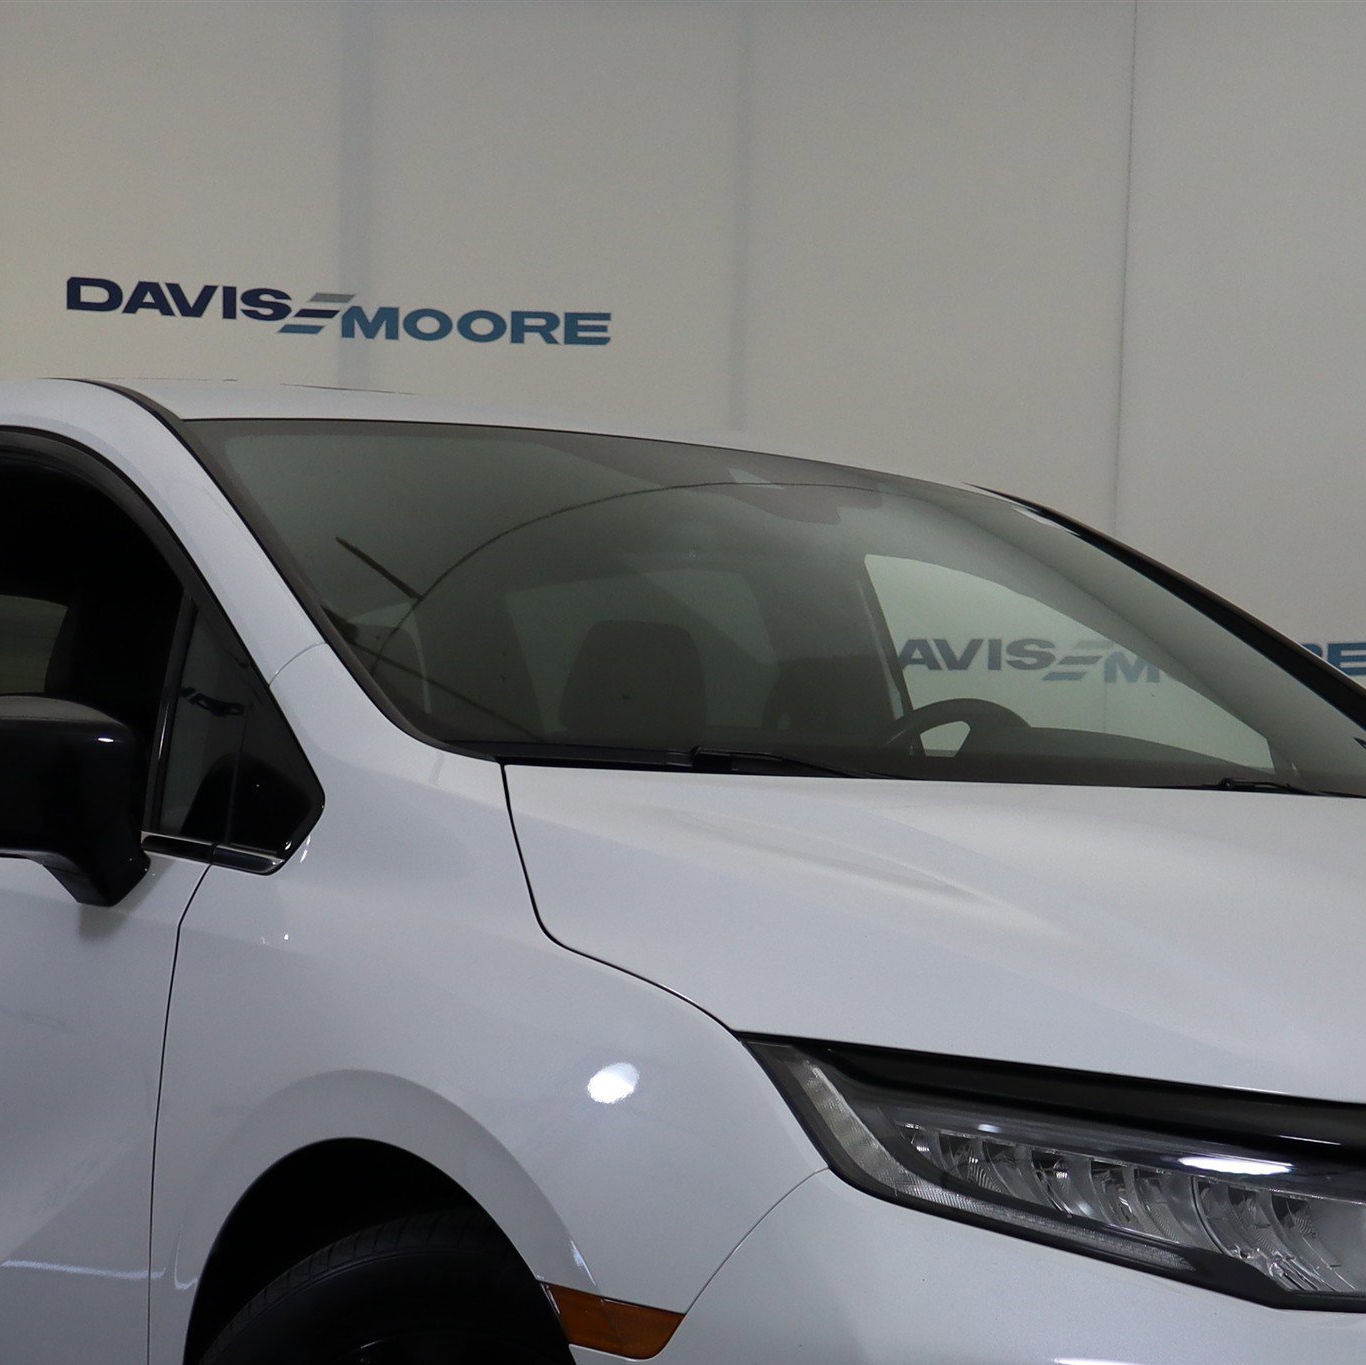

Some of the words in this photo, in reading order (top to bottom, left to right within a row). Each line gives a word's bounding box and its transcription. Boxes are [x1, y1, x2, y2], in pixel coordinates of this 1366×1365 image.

[66, 276, 293, 321] DAVIS
[340, 305, 612, 346] MOORE
[896, 637, 1054, 671] AVIS
